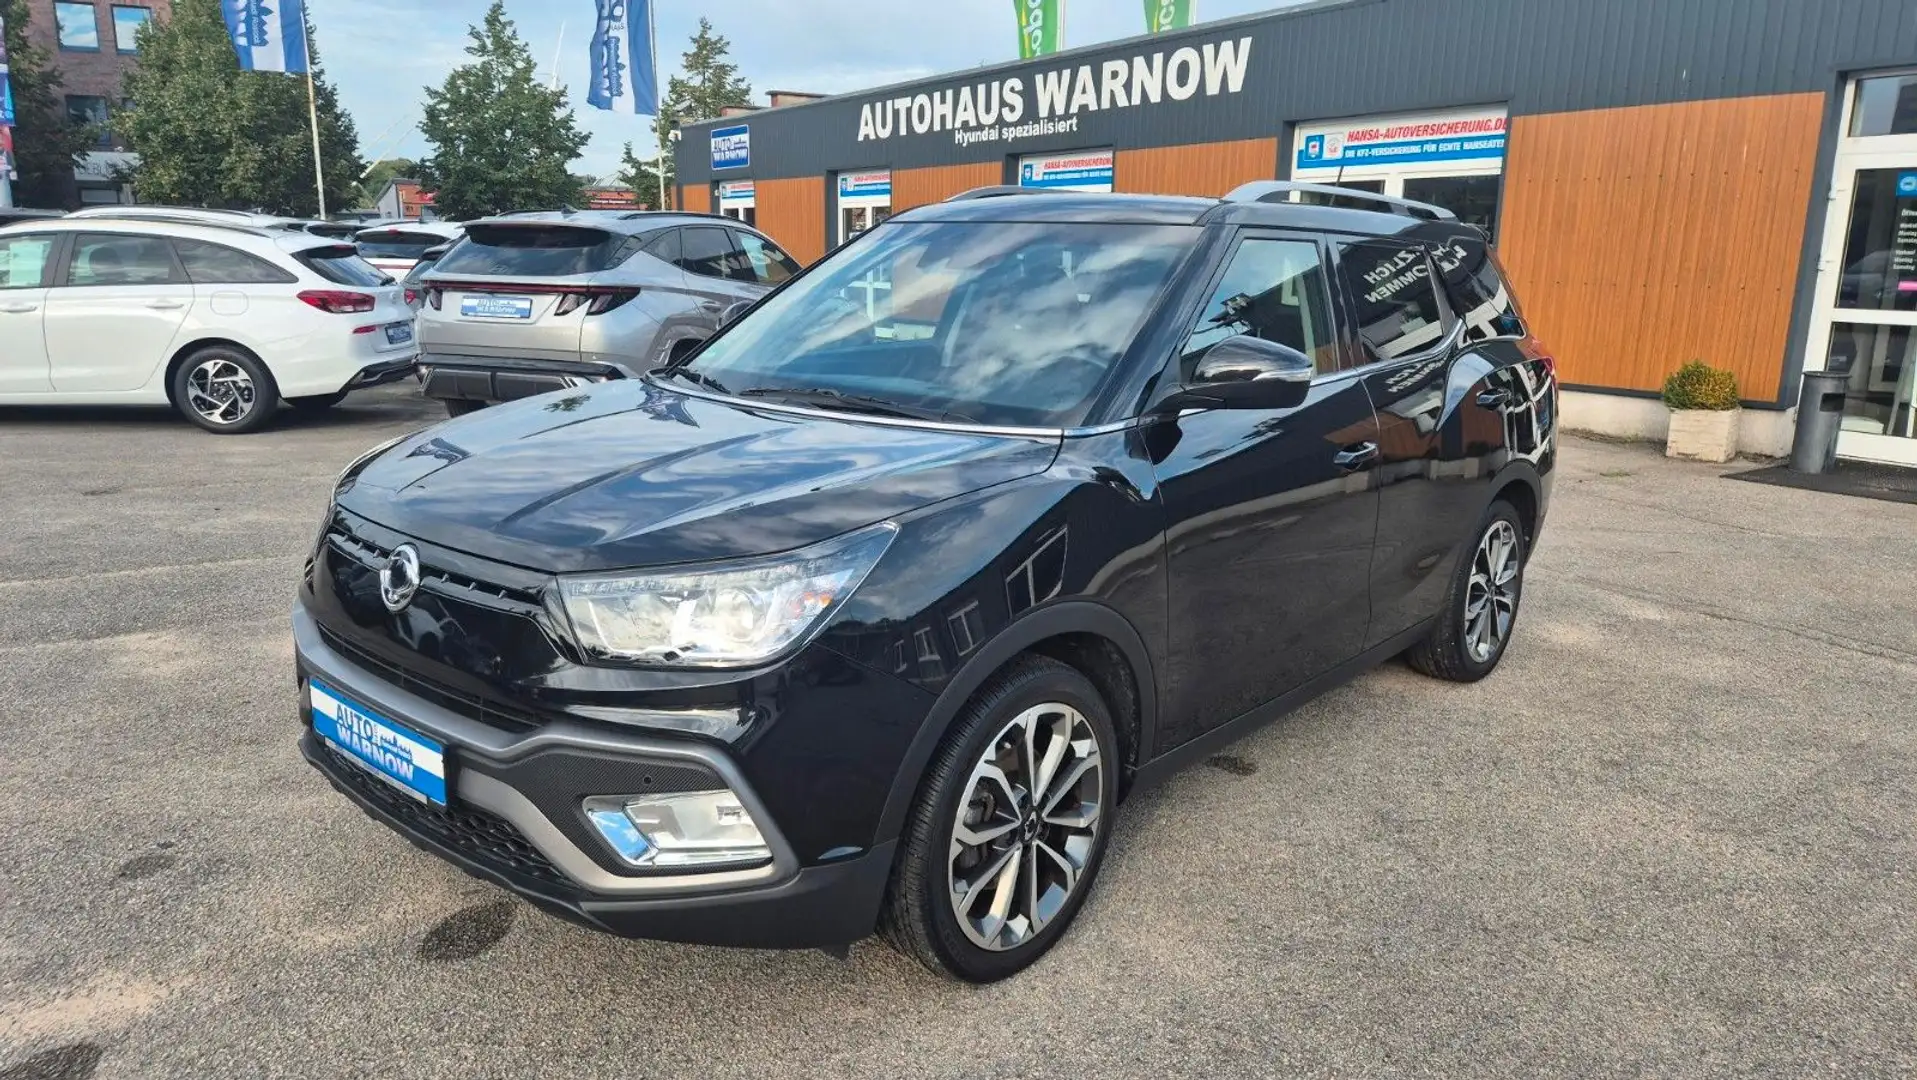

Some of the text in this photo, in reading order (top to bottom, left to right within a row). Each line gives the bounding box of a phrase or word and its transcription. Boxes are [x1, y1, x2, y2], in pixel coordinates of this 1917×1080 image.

[857, 36, 1253, 142] AUTOHAUS WARNOW
[954, 117, 1078, 147] Hyundai spezialisiert
[712, 149, 748, 162] WARNOW
[336, 703, 374, 741] AUTO
[336, 723, 414, 782] WARNOW
